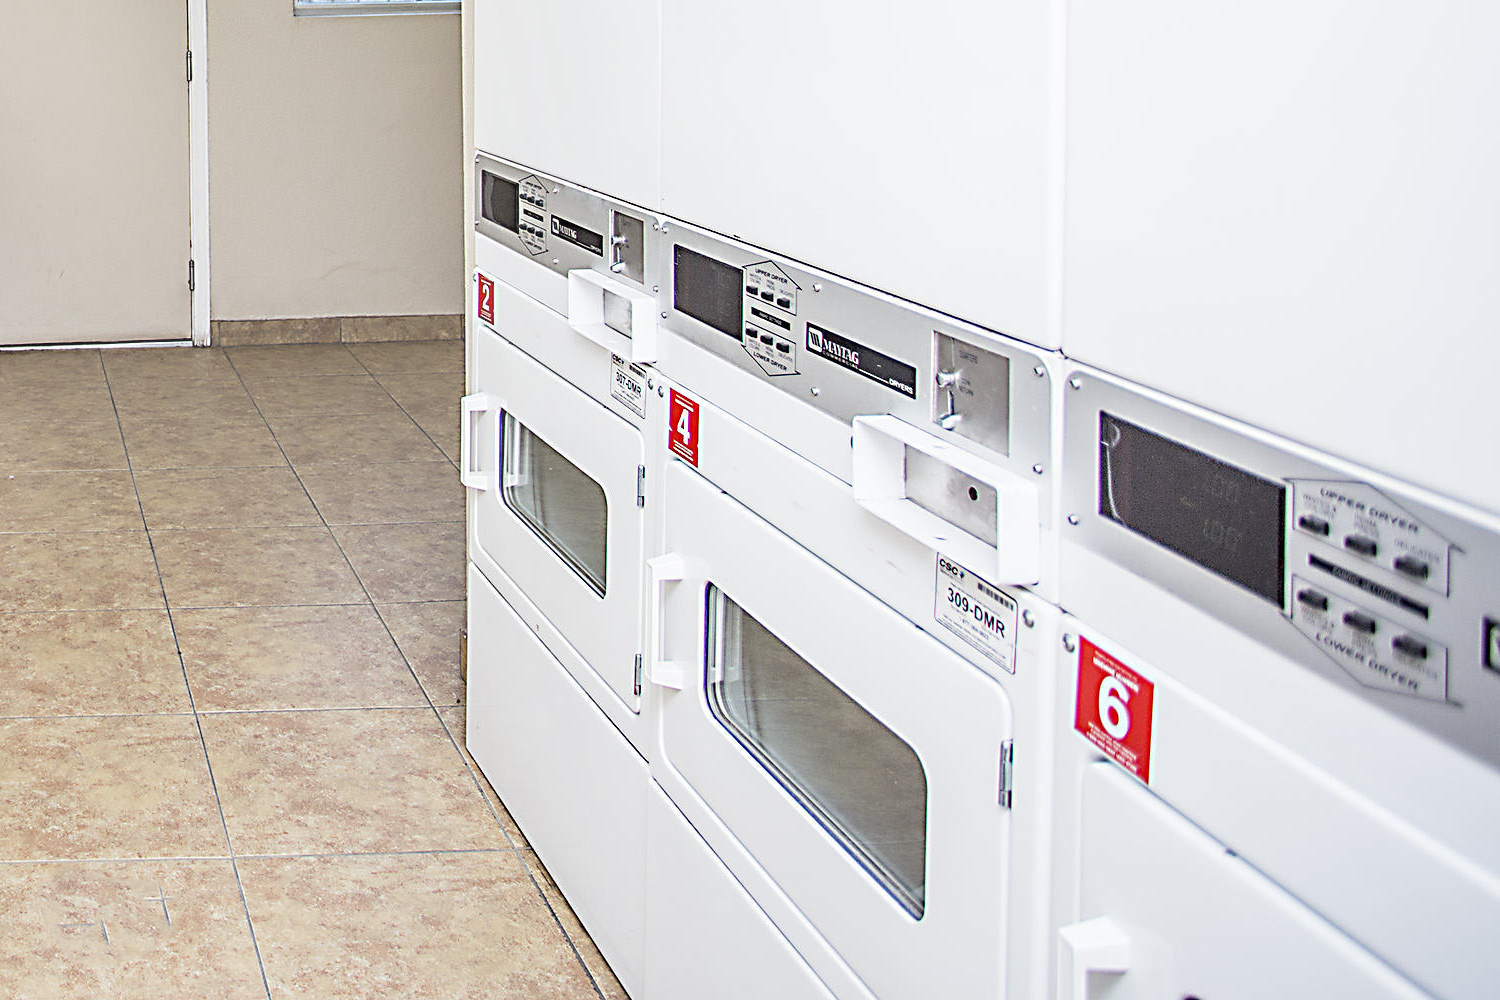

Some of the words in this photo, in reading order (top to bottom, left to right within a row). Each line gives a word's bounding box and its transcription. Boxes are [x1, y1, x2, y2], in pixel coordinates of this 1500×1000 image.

[755, 268, 772, 280] UPPER
[771, 274, 788, 285] DRYER
[482, 283, 490, 311] 2
[753, 352, 770, 363] LOWER
[770, 360, 788, 372] DRYER
[823, 338, 860, 365] MAYTAG
[888, 377, 914, 395] DRYERS
[677, 408, 691, 446] 4
[1320, 488, 1366, 511] UPPER
[1368, 507, 1419, 533] DRYER
[939, 558, 959, 576] CSC
[947, 587, 1006, 639] 309-DMR
[1315, 632, 1365, 663] LOWER
[1367, 659, 1419, 690] DRYER
[1098, 675, 1130, 741] 6
